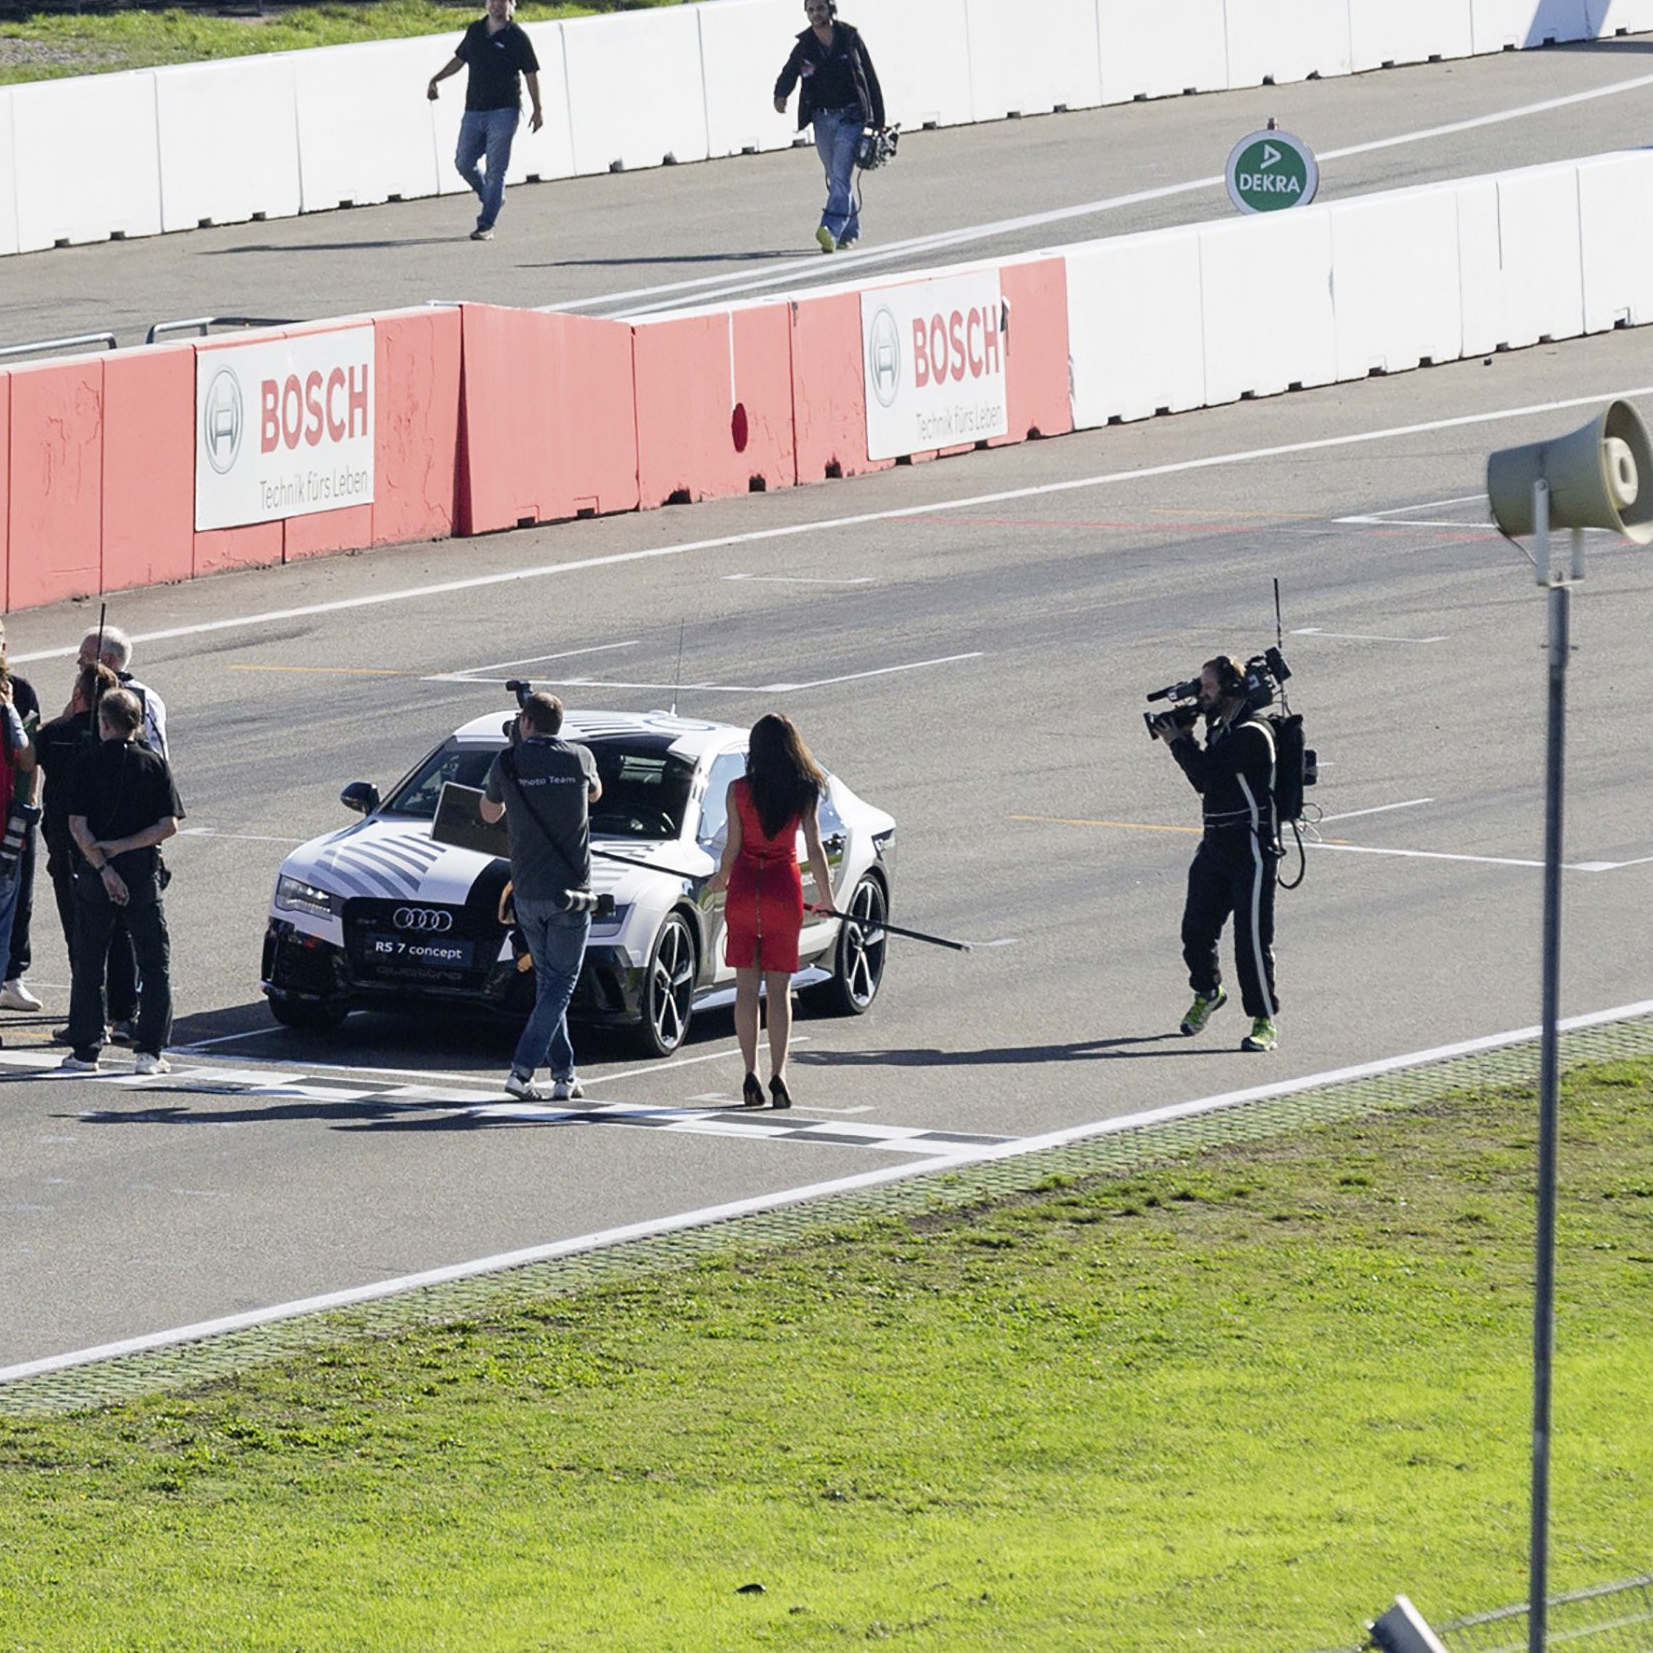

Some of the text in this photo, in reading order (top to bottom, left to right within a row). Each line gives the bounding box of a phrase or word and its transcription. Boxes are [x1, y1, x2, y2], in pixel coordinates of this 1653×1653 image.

[1239, 173, 1301, 194] DEKRA
[912, 305, 999, 388] BOSCH
[260, 363, 368, 453] BOSCH
[916, 400, 1001, 440] Technik fürs Leben
[259, 463, 368, 510] Technik fürs Leben
[548, 776, 576, 785] Team
[375, 941, 463, 960] RS 7 concept
